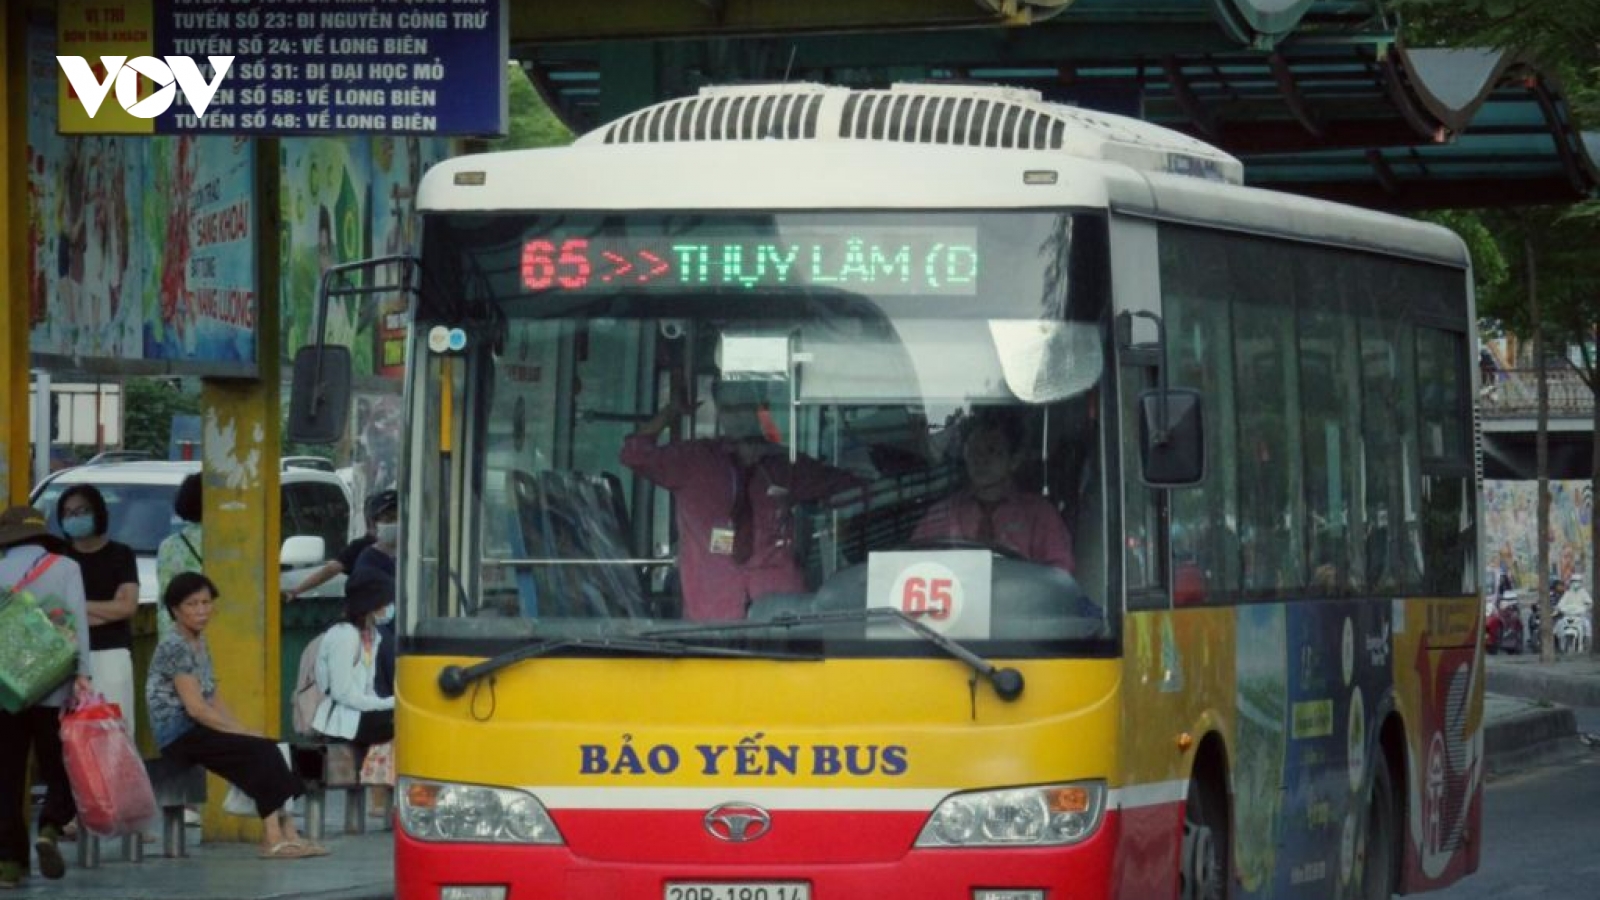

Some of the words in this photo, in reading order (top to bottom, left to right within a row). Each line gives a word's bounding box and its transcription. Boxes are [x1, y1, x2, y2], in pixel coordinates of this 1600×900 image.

[173, 7, 230, 28] TUYẾN
[235, 7, 261, 28] SỐ
[264, 12, 293, 28] 23:
[398, 8, 447, 28] CÔNG
[173, 33, 232, 54] TUYẾN
[238, 33, 263, 54] SỐ
[268, 38, 297, 54] 24:
[330, 38, 378, 54] LONG
[383, 33, 428, 54] BIÊN
[240, 58, 266, 79] SỐ
[271, 63, 298, 79] 31:
[369, 63, 408, 83] HỌC
[413, 57, 445, 80] MỎ
[240, 83, 266, 105] SỐ
[271, 88, 303, 105] 58:
[335, 88, 385, 106] LONG
[391, 85, 437, 106] BIÊN
[175, 108, 235, 128] TUYẾN
[241, 108, 266, 128] SỐ
[271, 113, 301, 128] 48:
[336, 114, 386, 129] LONG
[391, 112, 437, 130] BIÊN
[522, 238, 592, 290] 65
[672, 244, 800, 288] THỤY
[811, 237, 910, 283] LÂM
[901, 577, 952, 622] 65
[579, 733, 680, 776] BẢO
[695, 732, 801, 776] YẾN
[811, 744, 909, 776] BUS
